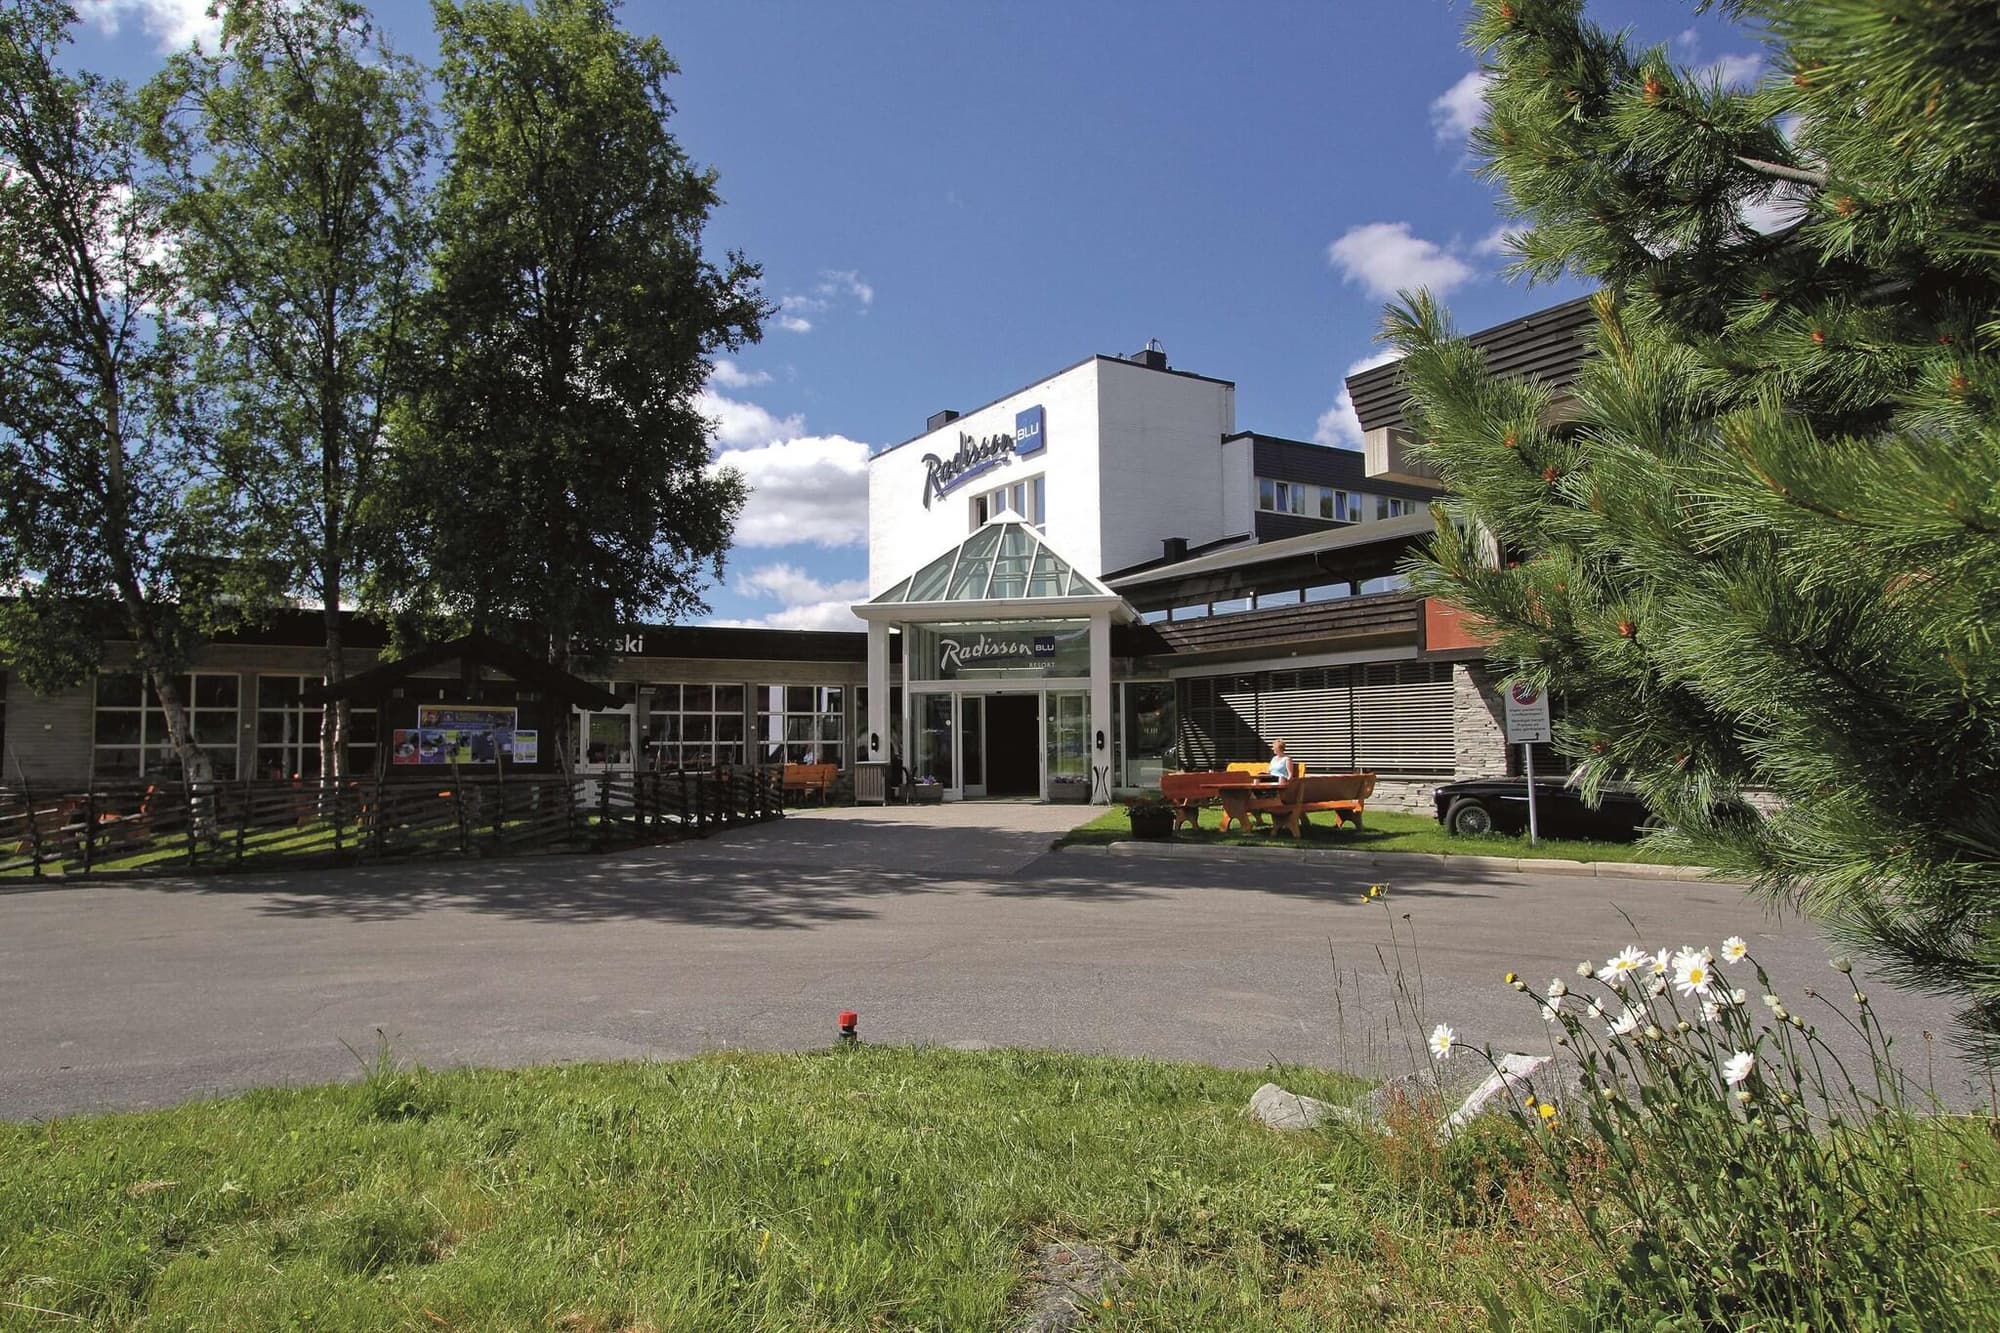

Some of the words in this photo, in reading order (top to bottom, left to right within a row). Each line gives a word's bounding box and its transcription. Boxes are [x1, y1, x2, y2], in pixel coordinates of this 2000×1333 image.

[922, 430, 1016, 509] Radisson
[1017, 422, 1039, 440] BLU
[940, 633, 1032, 671] Radisson
[1035, 644, 1055, 652] BLU
[1029, 661, 1056, 669] RESORT
